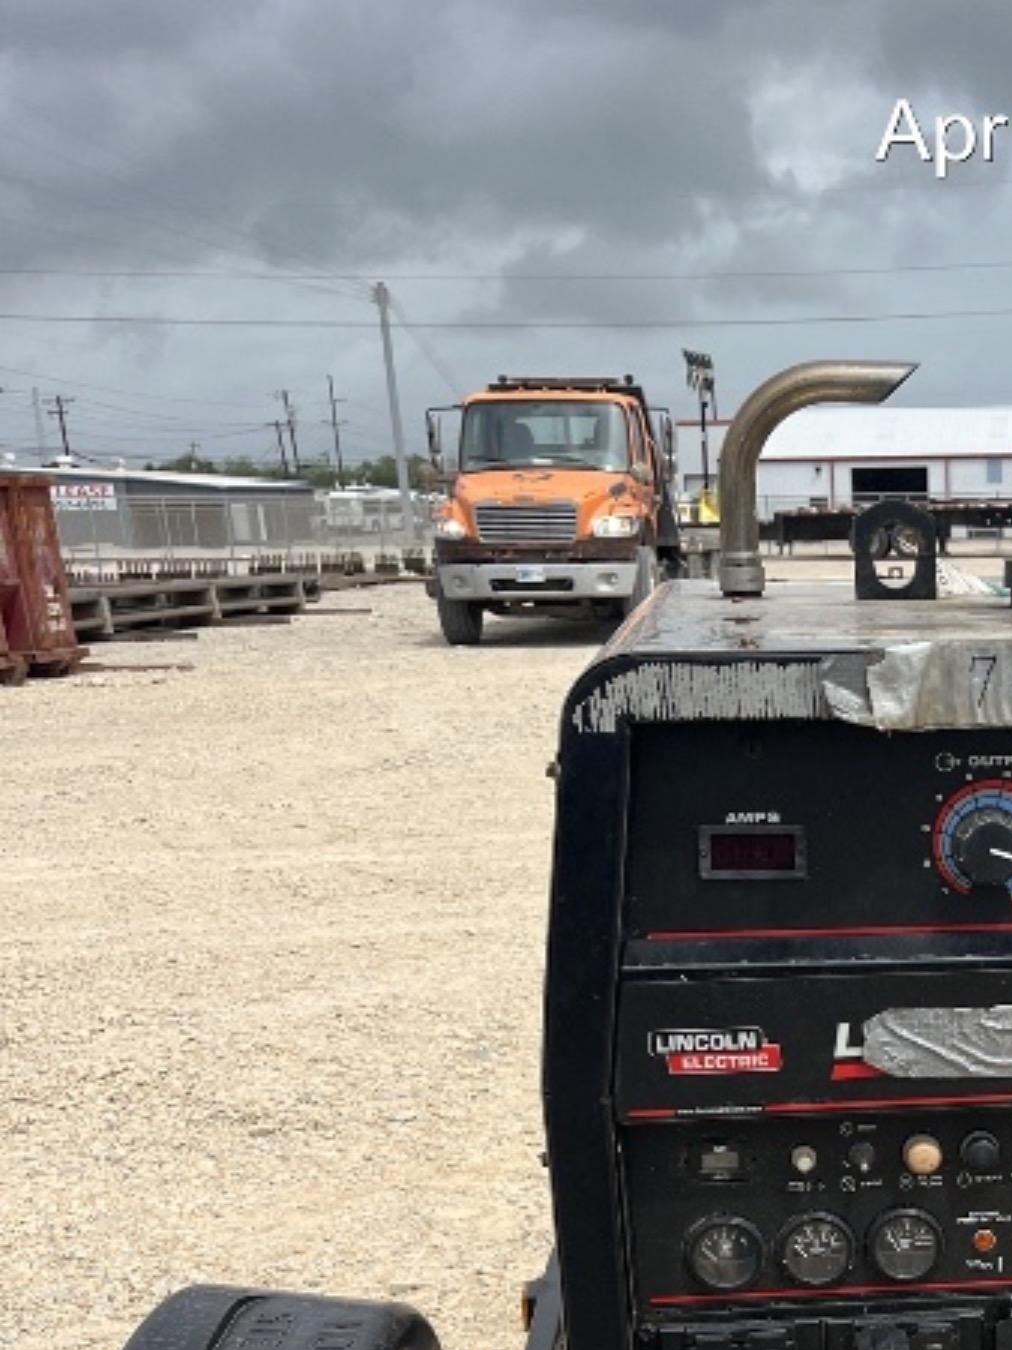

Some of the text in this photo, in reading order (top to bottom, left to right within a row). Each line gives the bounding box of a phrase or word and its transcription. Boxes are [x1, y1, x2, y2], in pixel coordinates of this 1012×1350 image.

[968, 655, 997, 708] 7
[725, 811, 781, 824] AMPS
[656, 1030, 758, 1054] LINCOLN
[682, 1053, 769, 1070] ELECTRIC
